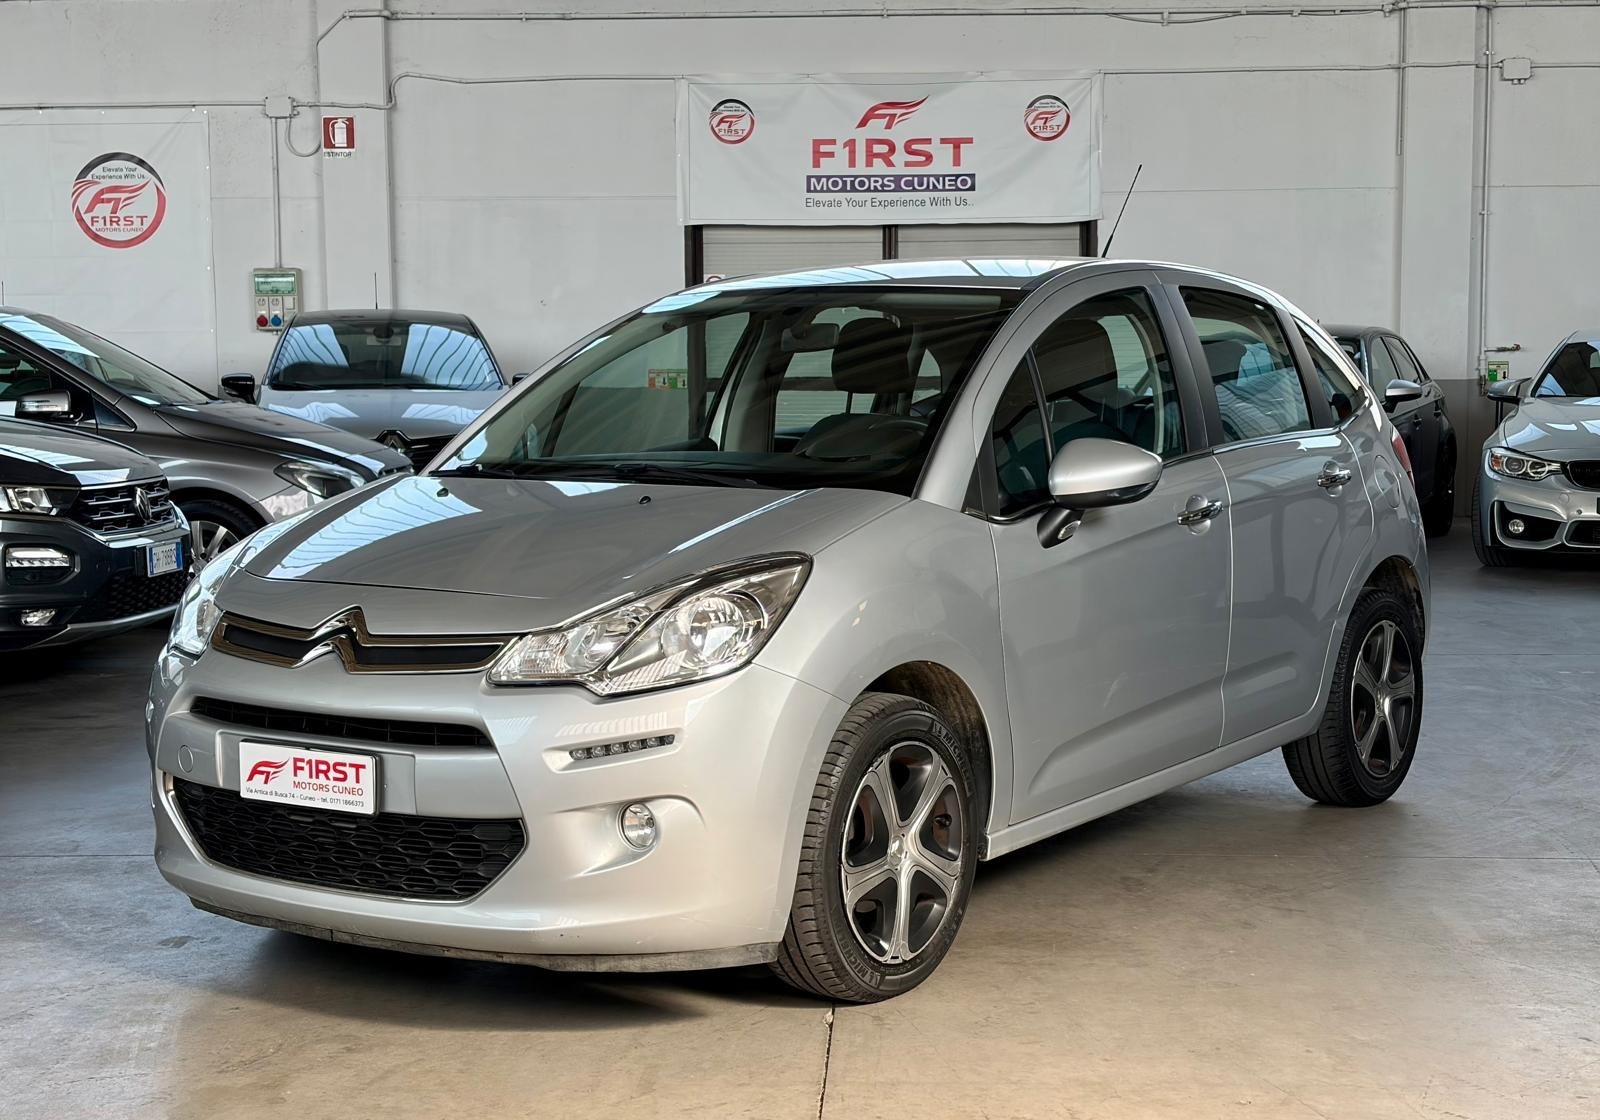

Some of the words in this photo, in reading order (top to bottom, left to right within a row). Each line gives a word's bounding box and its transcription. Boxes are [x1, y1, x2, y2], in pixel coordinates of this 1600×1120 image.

[812, 137, 974, 169] F1RST
[810, 177, 895, 190] MOTORS
[900, 176, 972, 190] CUNEO
[805, 197, 842, 208] Elevate
[844, 197, 868, 208] Your
[870, 197, 927, 209] Experience
[929, 196, 951, 207] With
[90, 215, 148, 227] F1RST
[292, 757, 367, 784] F1RST
[246, 786, 254, 794] Via
[292, 780, 330, 793] MOTORS
[331, 785, 364, 797] CUNEO
